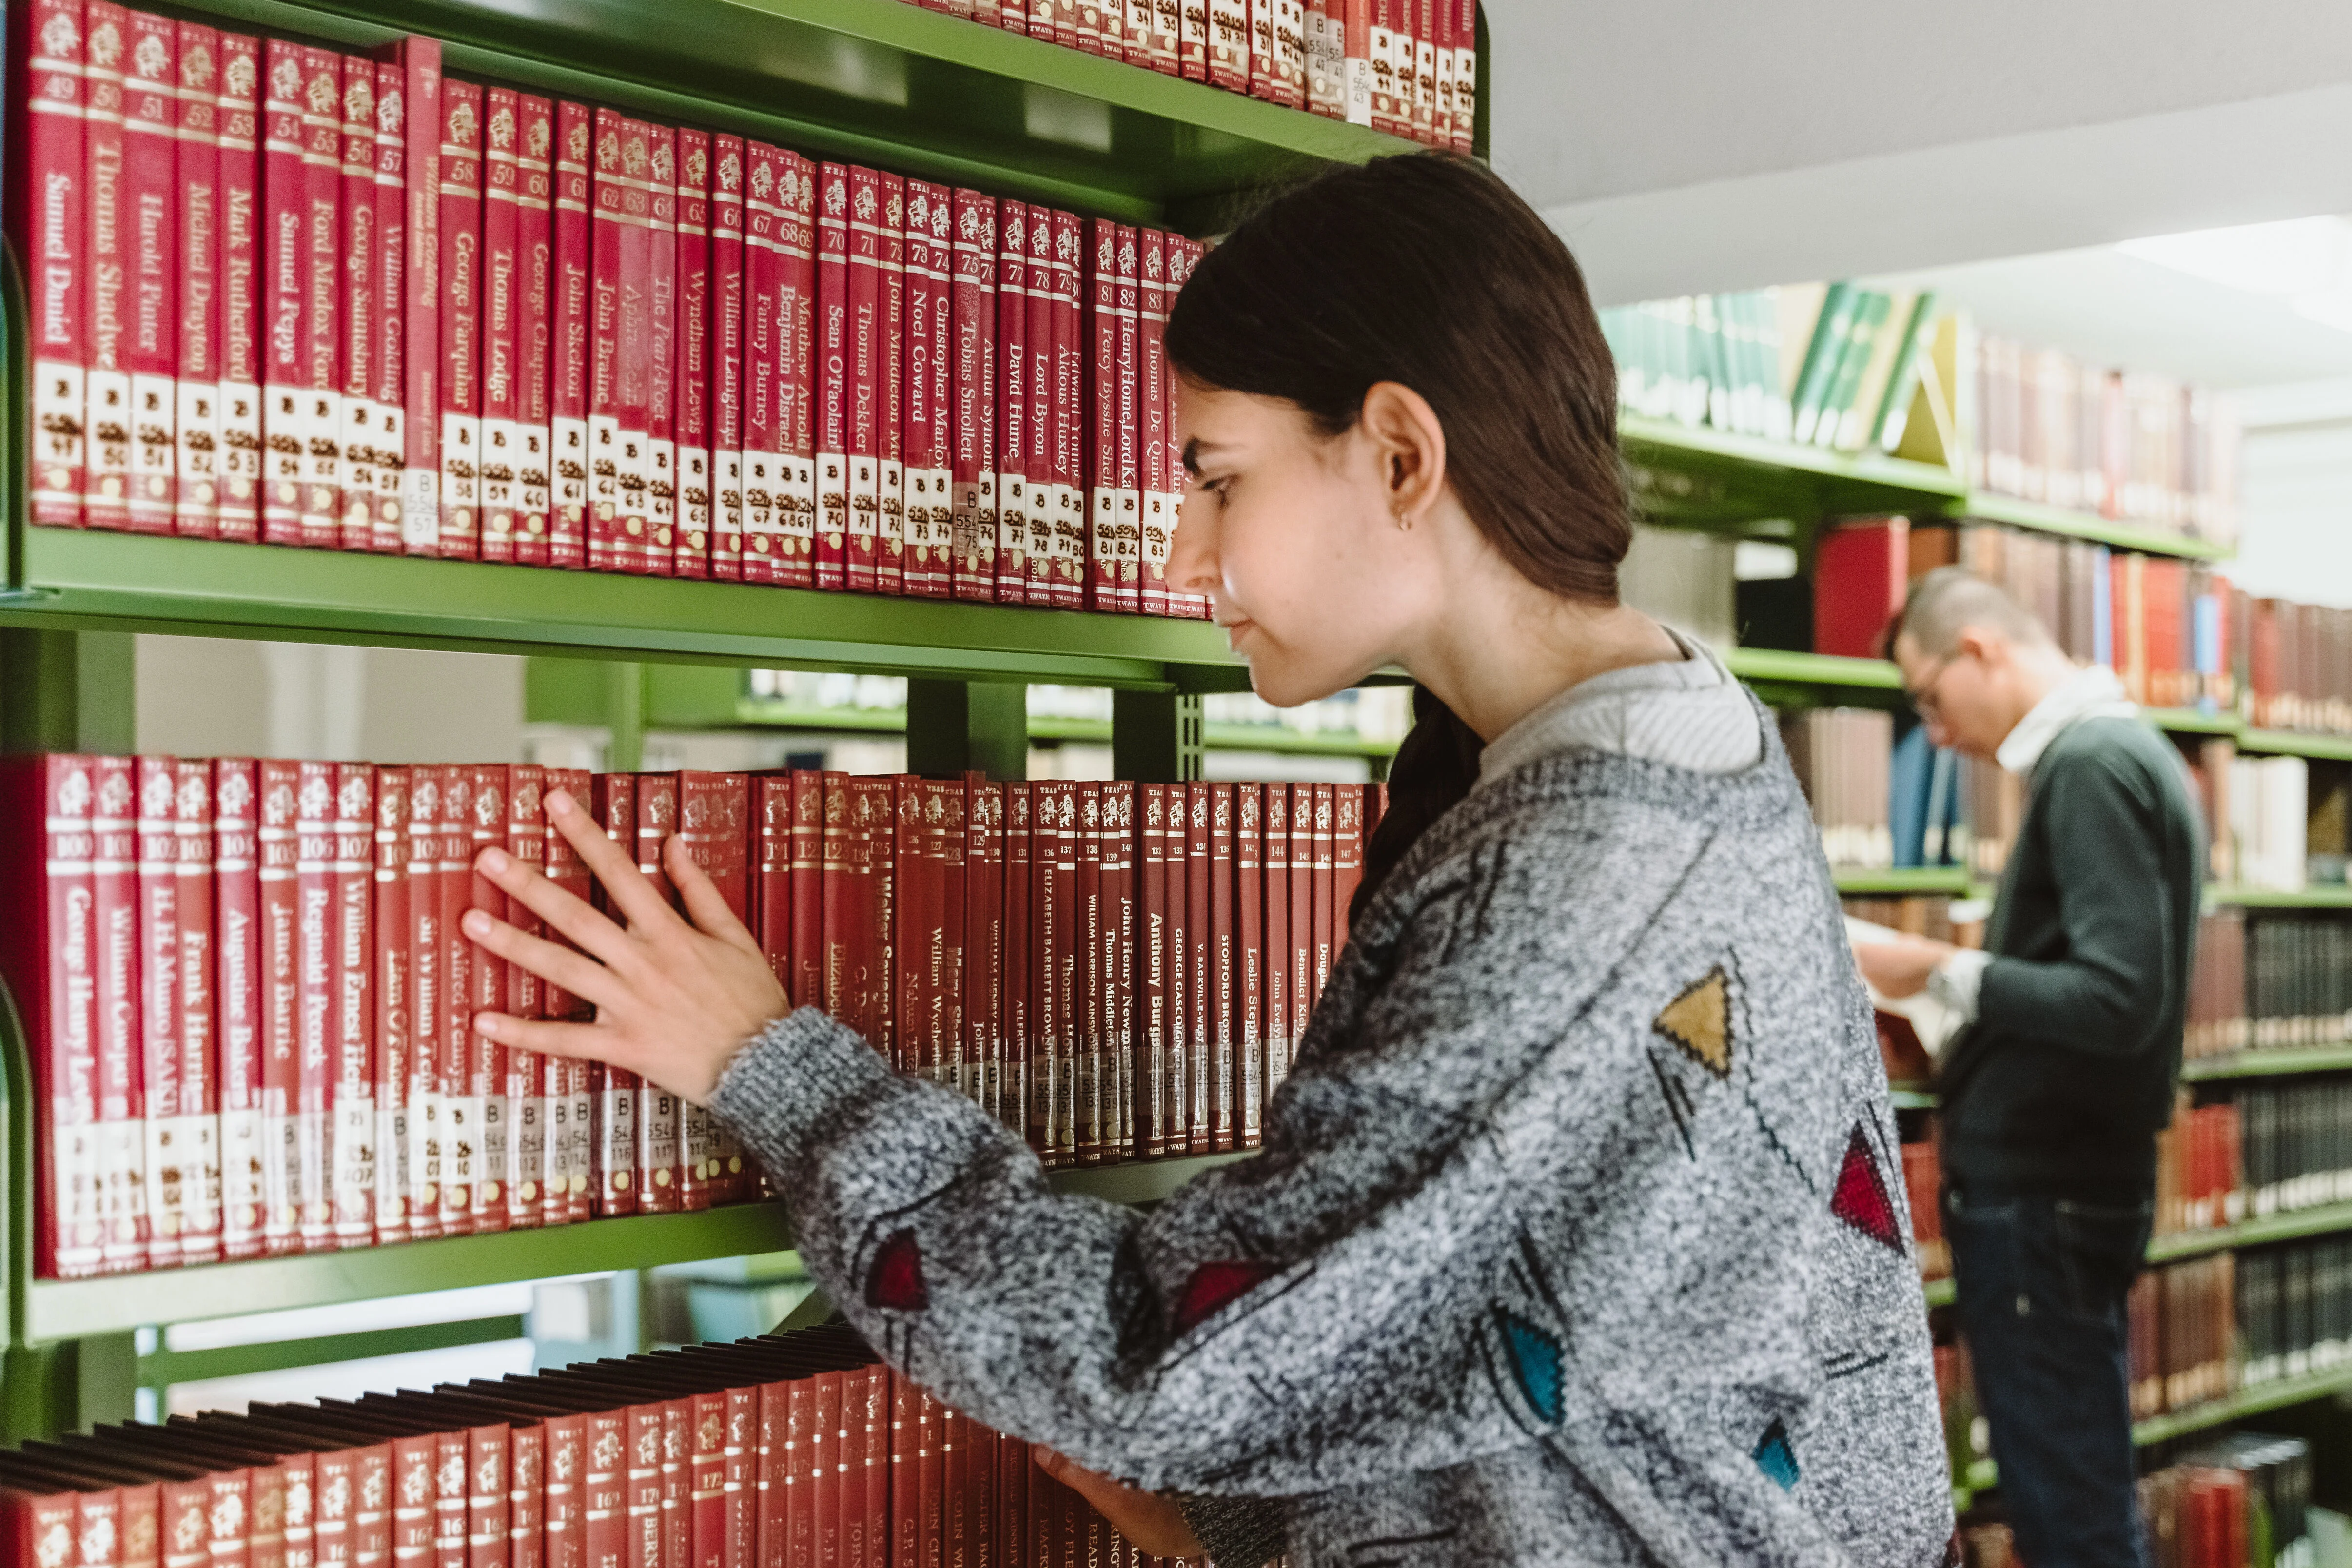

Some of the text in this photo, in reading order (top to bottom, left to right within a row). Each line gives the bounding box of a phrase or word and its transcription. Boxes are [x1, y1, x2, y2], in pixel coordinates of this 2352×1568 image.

[1137, 11, 1149, 25] 34
[1163, 17, 1176, 31] 35
[1317, 19, 1324, 33] B
[382, 151, 401, 172] 57
[451, 161, 475, 182] 58
[493, 164, 515, 186] 59
[95, 139, 122, 253] Thomas
[229, 187, 252, 249] Mark
[754, 215, 771, 234] 67
[780, 222, 798, 242] 68
[828, 231, 845, 251] 70
[861, 235, 875, 255] 71
[45, 173, 72, 343] Samuel Daniel
[139, 195, 163, 353] Harold Pinter
[184, 181, 211, 372] Michael Drayton
[313, 199, 335, 335] Ford Madox
[912, 244, 928, 264] 73
[934, 252, 950, 271] 74
[962, 254, 978, 273] 75
[980, 263, 995, 282] 76
[1008, 264, 1024, 283] 77
[274, 212, 300, 363] Samuel Pepys
[347, 206, 374, 399] George Saintsbury
[1035, 270, 1050, 289] 78
[1059, 273, 1072, 291] 79
[1101, 285, 1113, 303] 81
[1120, 288, 1135, 308] 82
[1148, 293, 1162, 310] 83
[380, 226, 402, 402] William Golding
[450, 231, 475, 408] George Farquhar
[490, 248, 513, 403] Thomas Lodge
[528, 243, 549, 418] George Chapman
[567, 262, 585, 399] John Skelton
[829, 305, 843, 349] Sean
[596, 279, 616, 404] John Braine
[654, 276, 670, 422] The Pearl-Poet
[686, 270, 705, 435] Wyndham Lewis
[719, 271, 740, 445] William Langland
[751, 292, 771, 431] Fanny Burney
[888, 276, 902, 423] John Middleton
[912, 289, 927, 423] Noel Coward
[931, 296, 950, 402] Christopher
[1098, 327, 1113, 374] Percy
[776, 283, 796, 454] Benjamin Disraeli
[796, 294, 811, 451] Matthew Arnold
[856, 302, 873, 453] Thomas Dekker
[960, 321, 977, 462] Tobias Smollett
[1117, 316, 1135, 467] Henry Home, Lord
[1149, 337, 1161, 402] Thomas
[979, 337, 995, 472] Arthur Symons
[1008, 342, 1023, 459] David Hume
[1032, 352, 1049, 456] Lord Byron
[1055, 343, 1071, 475] Aldous Huxley
[1071, 351, 1081, 479] Edward Young
[1098, 380, 1113, 438] Bysshe
[1150, 409, 1162, 433] De
[420, 474, 431, 493] B
[968, 491, 976, 508] B
[1124, 498, 1134, 510] B
[828, 513, 843, 526] 70
[965, 535, 977, 548] 75
[1117, 541, 1136, 556] 82
[1151, 544, 1164, 557] 83
[930, 841, 942, 851] 127
[974, 835, 985, 847] 129
[1043, 849, 1054, 857] 136
[1060, 846, 1072, 854] 137
[1086, 845, 1098, 854] 138
[1106, 853, 1117, 862] 139
[1121, 843, 1132, 852] 140
[1151, 847, 1162, 855] 132
[1173, 846, 1183, 855] 133
[1220, 845, 1230, 854] 135
[1271, 845, 1284, 857] 144
[1044, 869, 1052, 993] ELIZABETH BARRETT
[1088, 894, 1097, 997] WILLIAM HARRISON
[1120, 897, 1132, 990] John Henry
[1148, 912, 1163, 988] Anthony
[1175, 928, 1183, 980] GEORGE
[1197, 943, 1204, 953] V.
[931, 927, 942, 987] William
[1221, 934, 1230, 1000] STOPFORD
[1247, 947, 1258, 991] Leslie
[1317, 943, 1329, 990] Douglas
[1062, 954, 1074, 1019] Thomas
[1104, 928, 1116, 1048] Thomas Middleton
[1274, 970, 1282, 999] John
[1296, 948, 1307, 1035] Benedict Kiely
[659, 1097, 670, 1114] B
[953, 1490, 964, 1540] COLIN
